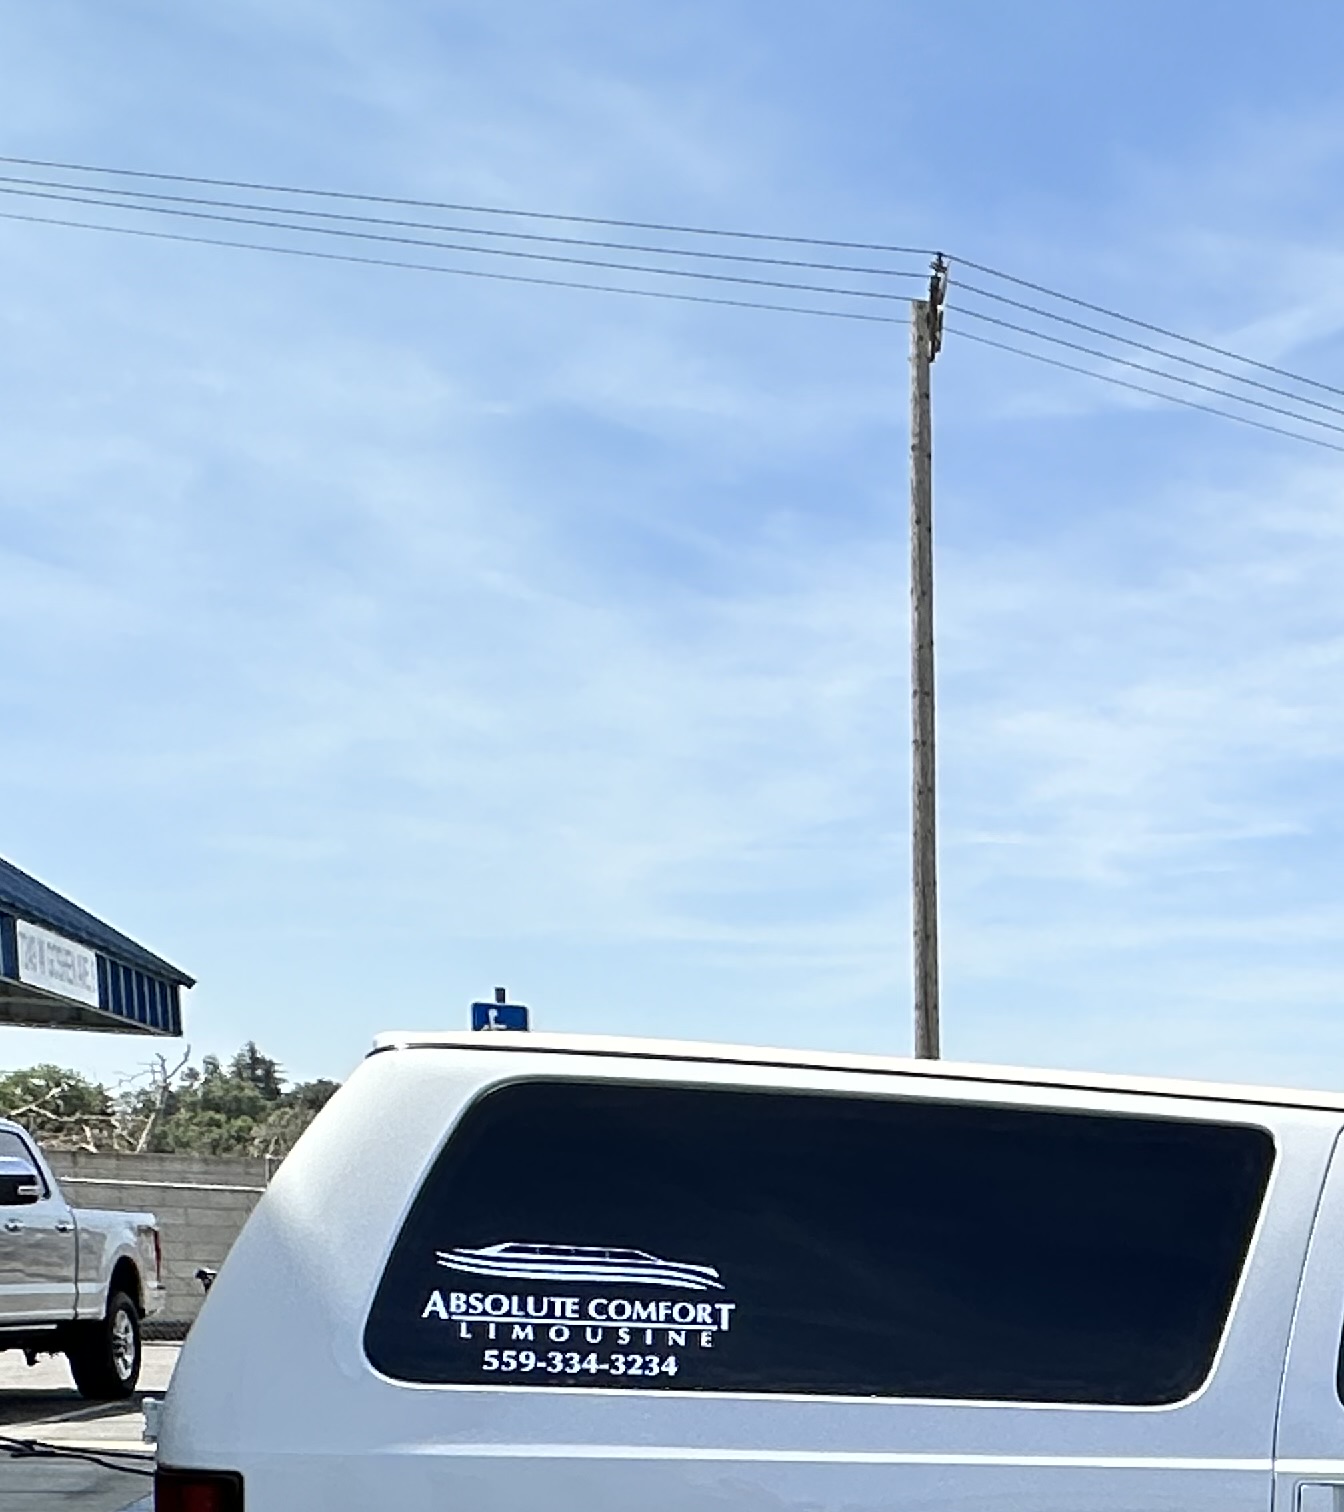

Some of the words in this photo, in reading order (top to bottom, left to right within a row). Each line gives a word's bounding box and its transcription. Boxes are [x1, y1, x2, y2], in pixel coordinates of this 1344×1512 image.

[421, 1290, 580, 1320] ABSOLUTE
[587, 1298, 736, 1331] COMFORT
[459, 1321, 713, 1348] LIMOUSINE
[482, 1350, 678, 1376] 559-334-3234
